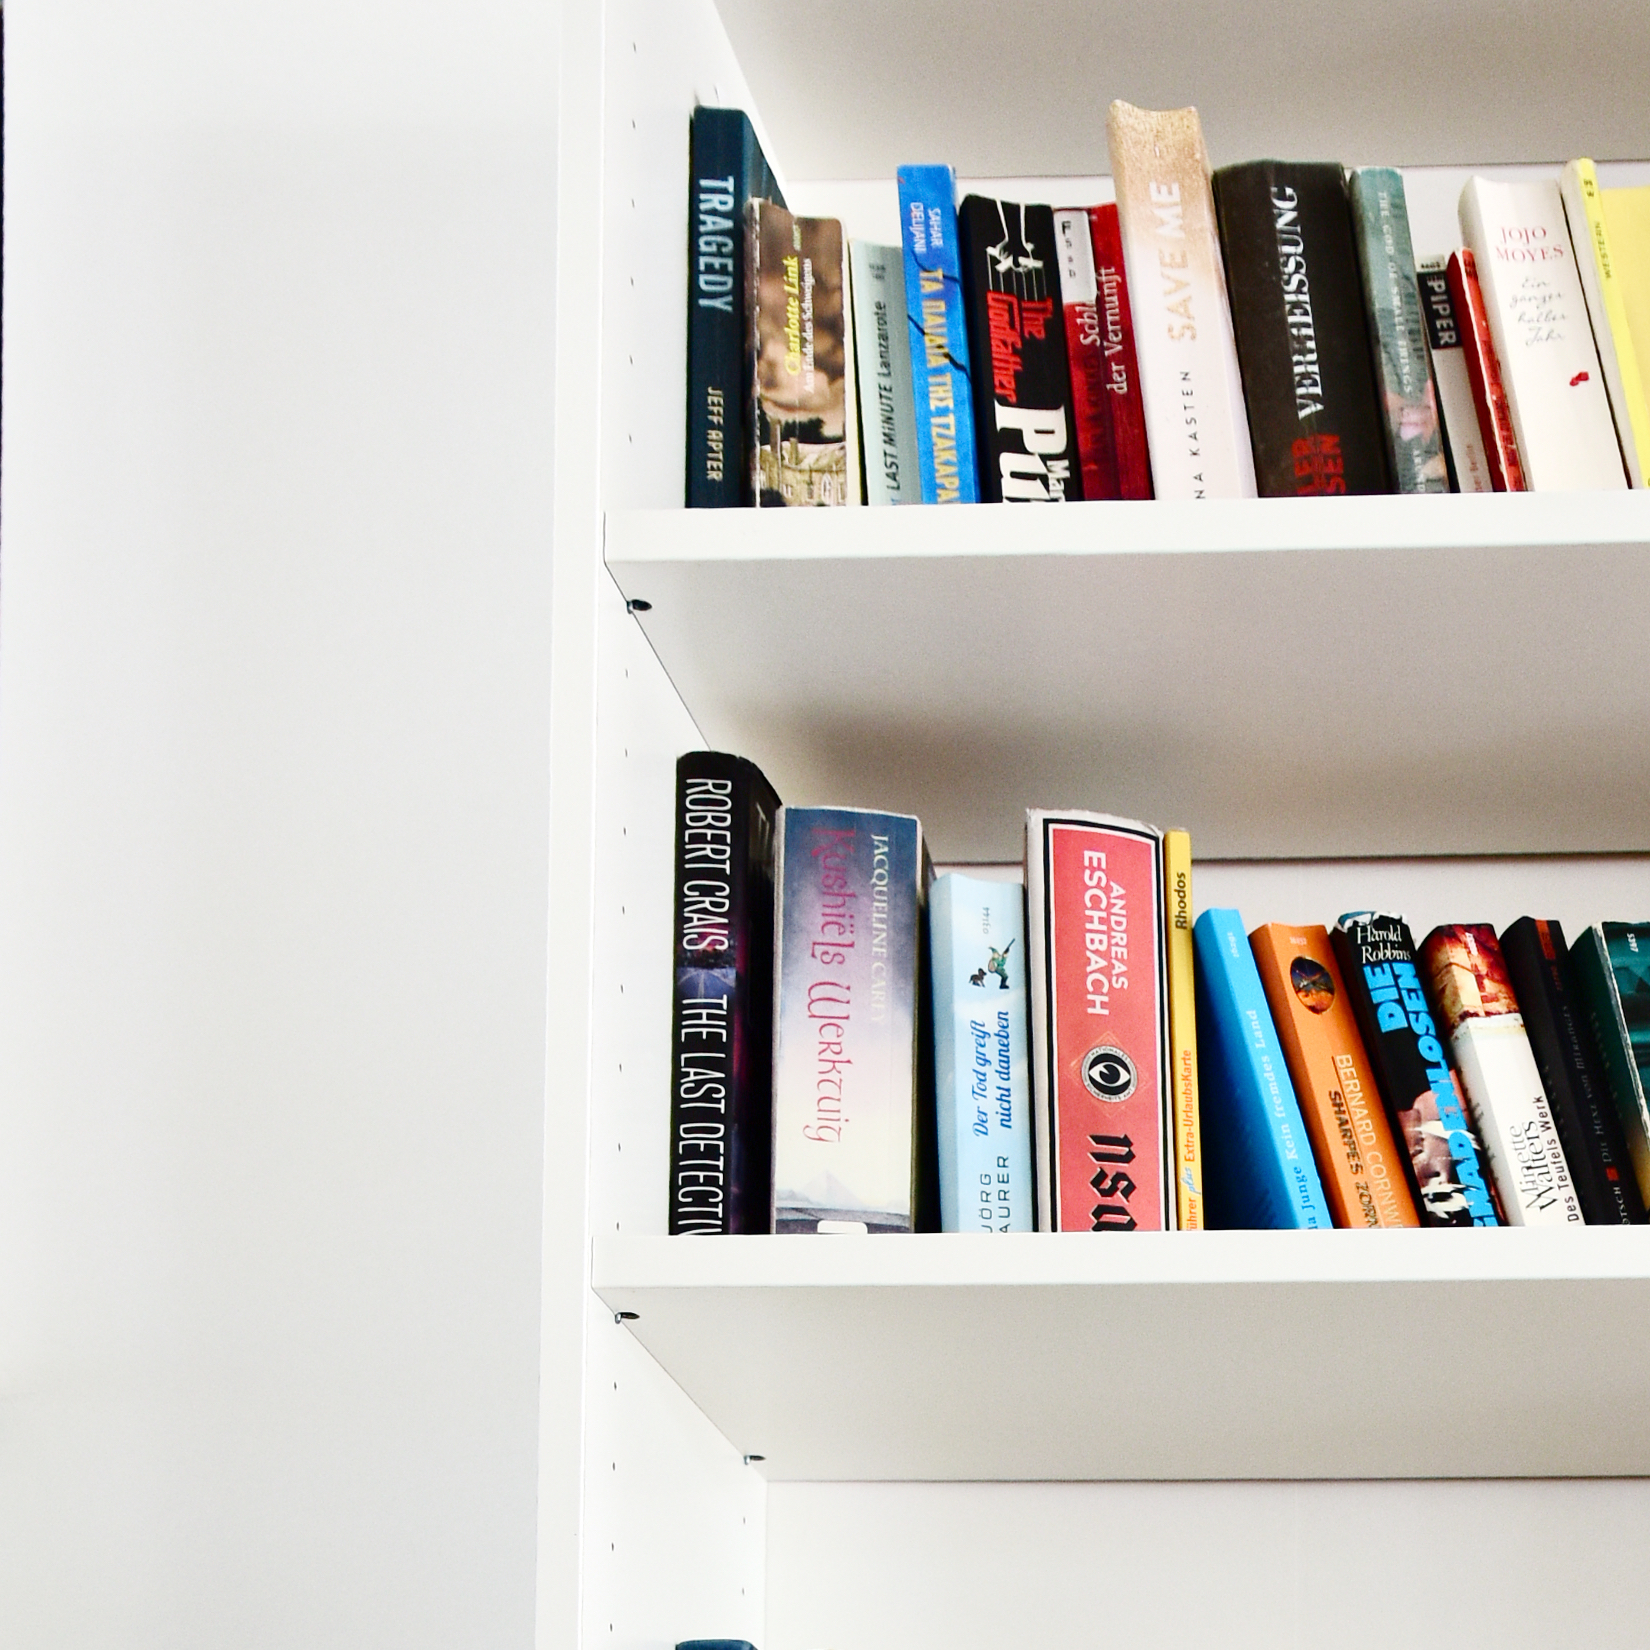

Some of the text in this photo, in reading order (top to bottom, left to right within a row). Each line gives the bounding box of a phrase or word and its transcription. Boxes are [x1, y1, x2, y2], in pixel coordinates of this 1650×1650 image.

[698, 176, 734, 313] TRAGEDY
[784, 255, 798, 288] Link
[929, 207, 943, 247] SAHAR
[1150, 181, 1197, 343] SAVE ME
[1496, 244, 1564, 262] MOYES
[1500, 226, 1548, 246] JOJO
[784, 290, 802, 376] Charlotte
[1100, 266, 1127, 395] der Vernunft
[1270, 186, 1324, 420] VERHEISSUNG
[1427, 275, 1457, 346] PIPER
[706, 386, 724, 481] JEFF APTER
[1180, 370, 1199, 457] KASTEN
[679, 778, 732, 1117] ROBERT CRAIS THE LAST
[1084, 850, 1110, 1016] ESCHBACH
[1109, 880, 1129, 990] ANDREAS
[1174, 872, 1188, 930] Rhodos
[1356, 927, 1401, 943] Harold
[970, 1019, 989, 1137] Der Tod greift
[993, 1011, 1013, 1130] nicht daneben
[1508, 1124, 1540, 1211] Minette
[1521, 1119, 1559, 1213] Walters
[1532, 1095, 1579, 1222] Des Teufels Werk
